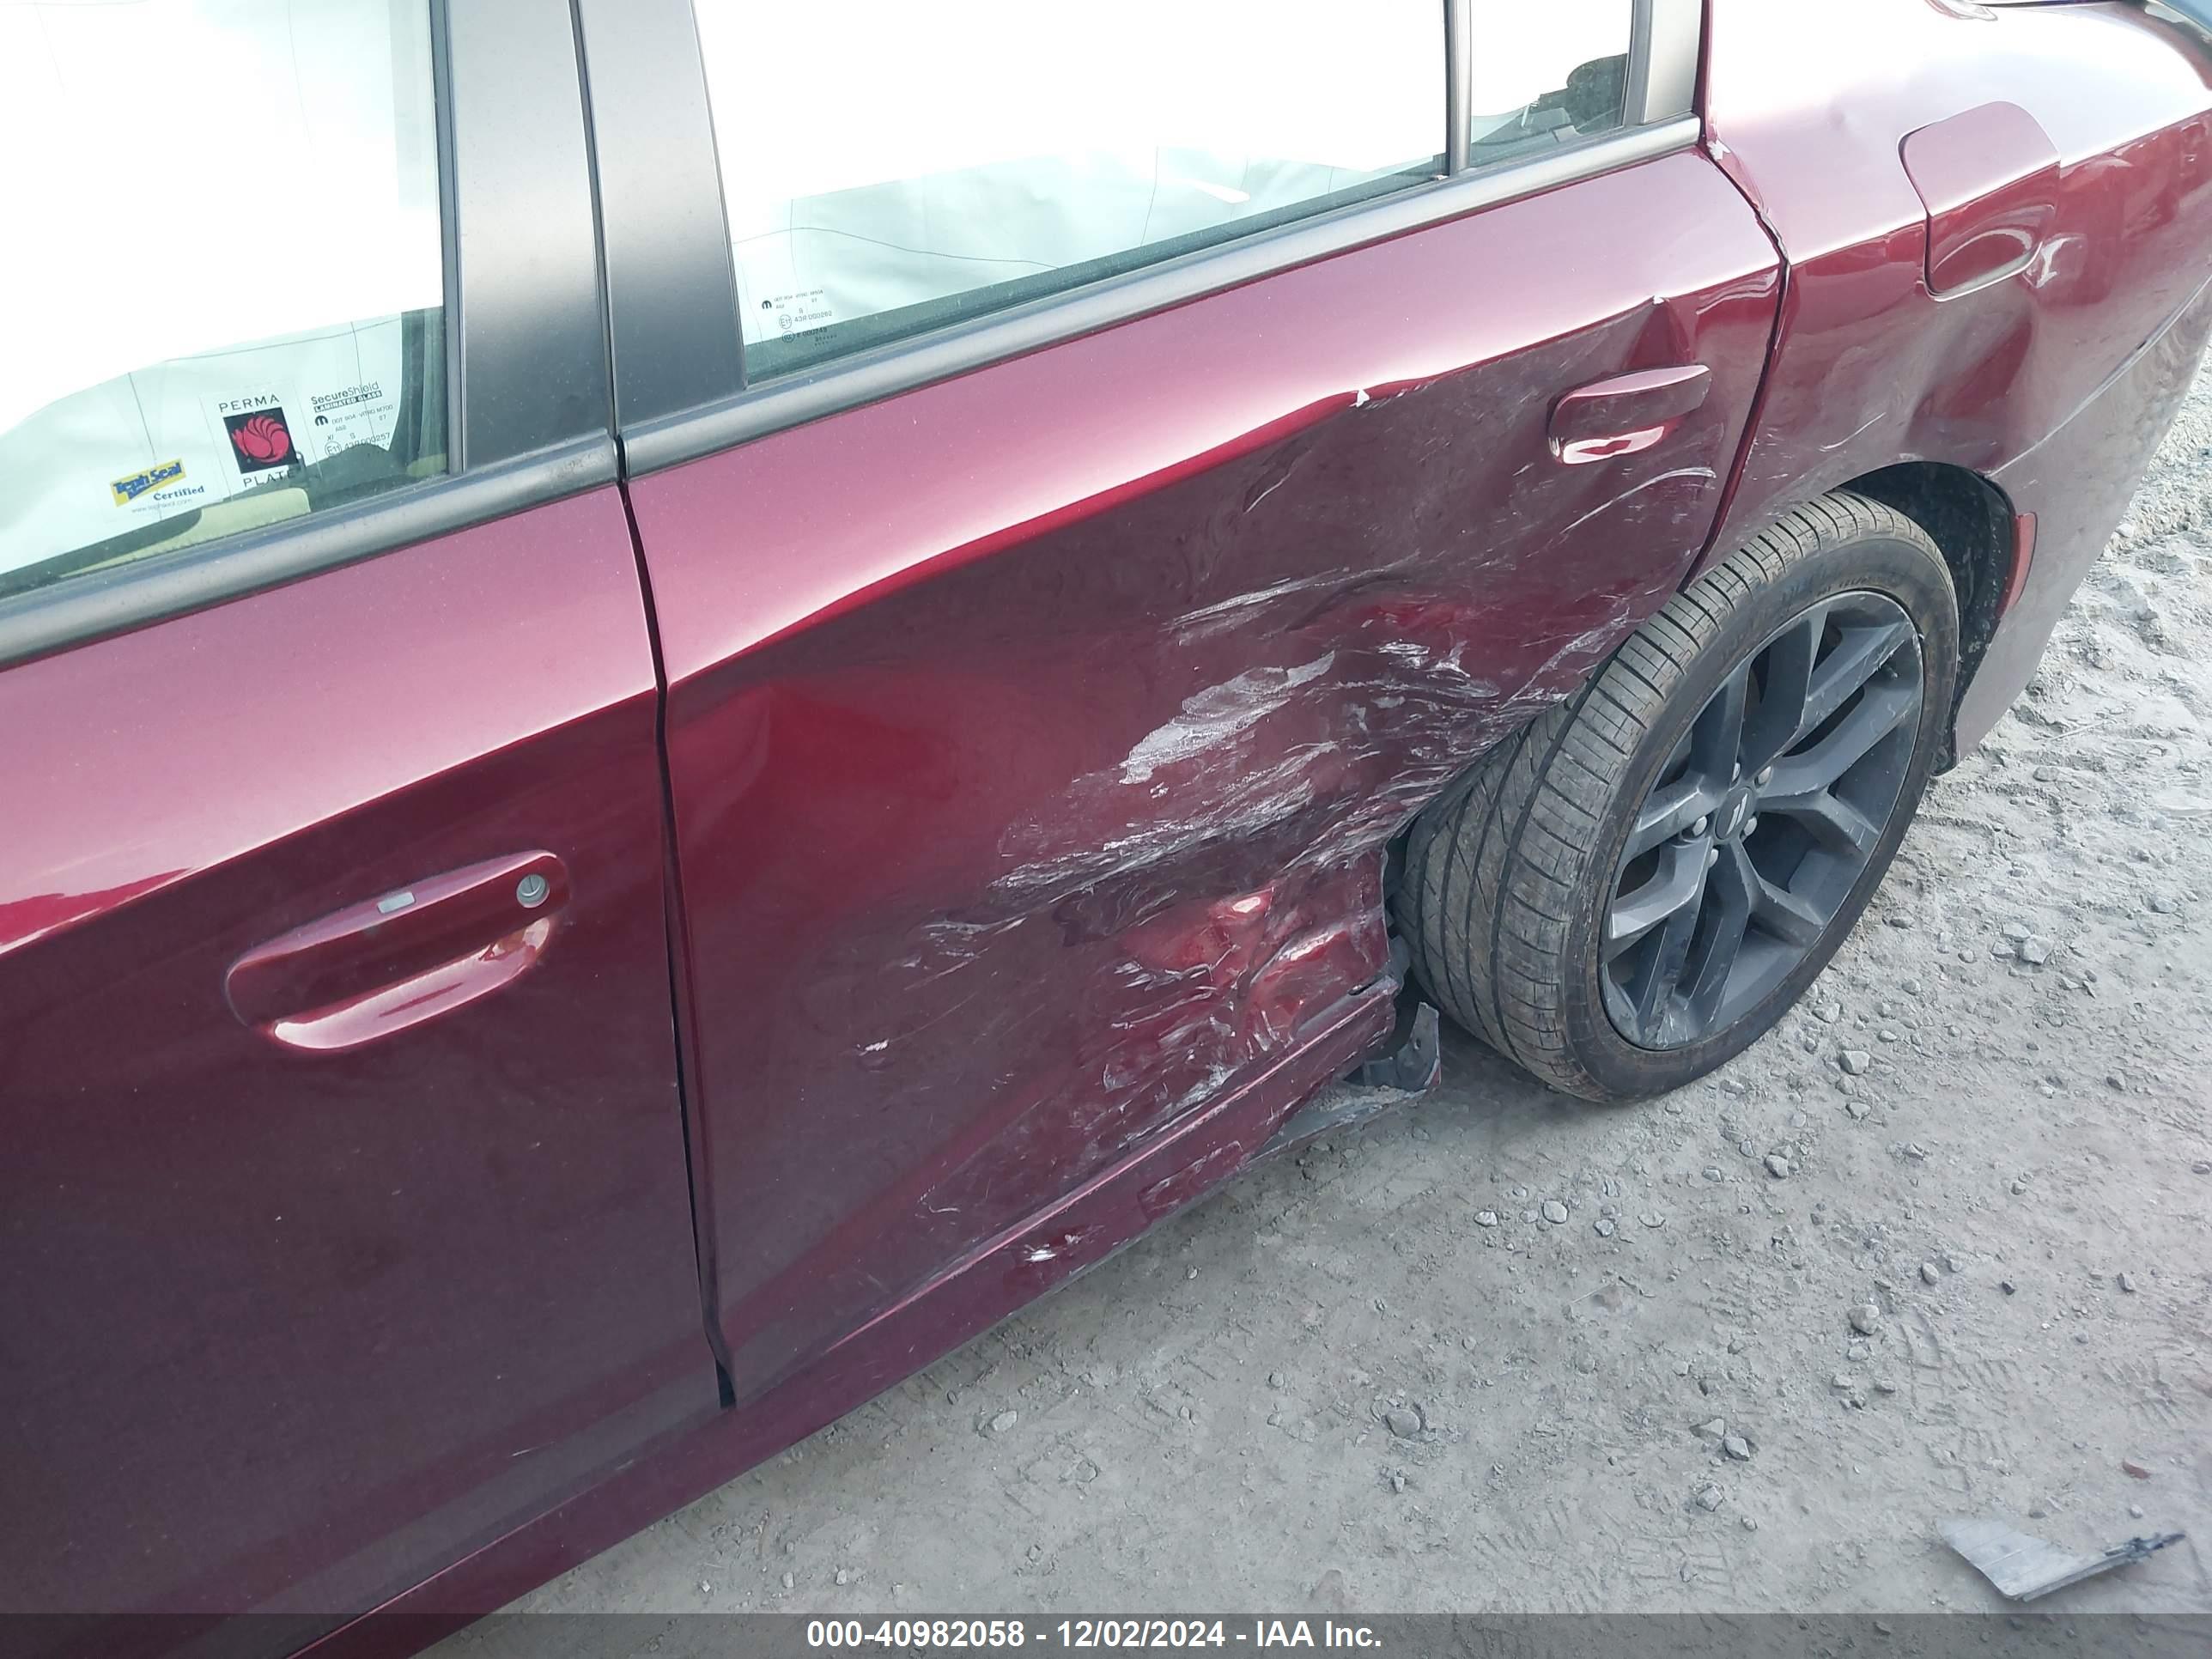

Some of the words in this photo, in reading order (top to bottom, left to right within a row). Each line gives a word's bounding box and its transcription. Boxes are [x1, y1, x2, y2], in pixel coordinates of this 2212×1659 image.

[311, 380, 380, 405] SecureShield
[218, 394, 280, 413] PERMA
[149, 462, 183, 483] Seal
[243, 469, 296, 489] PLATE
[154, 485, 205, 501] Certified
